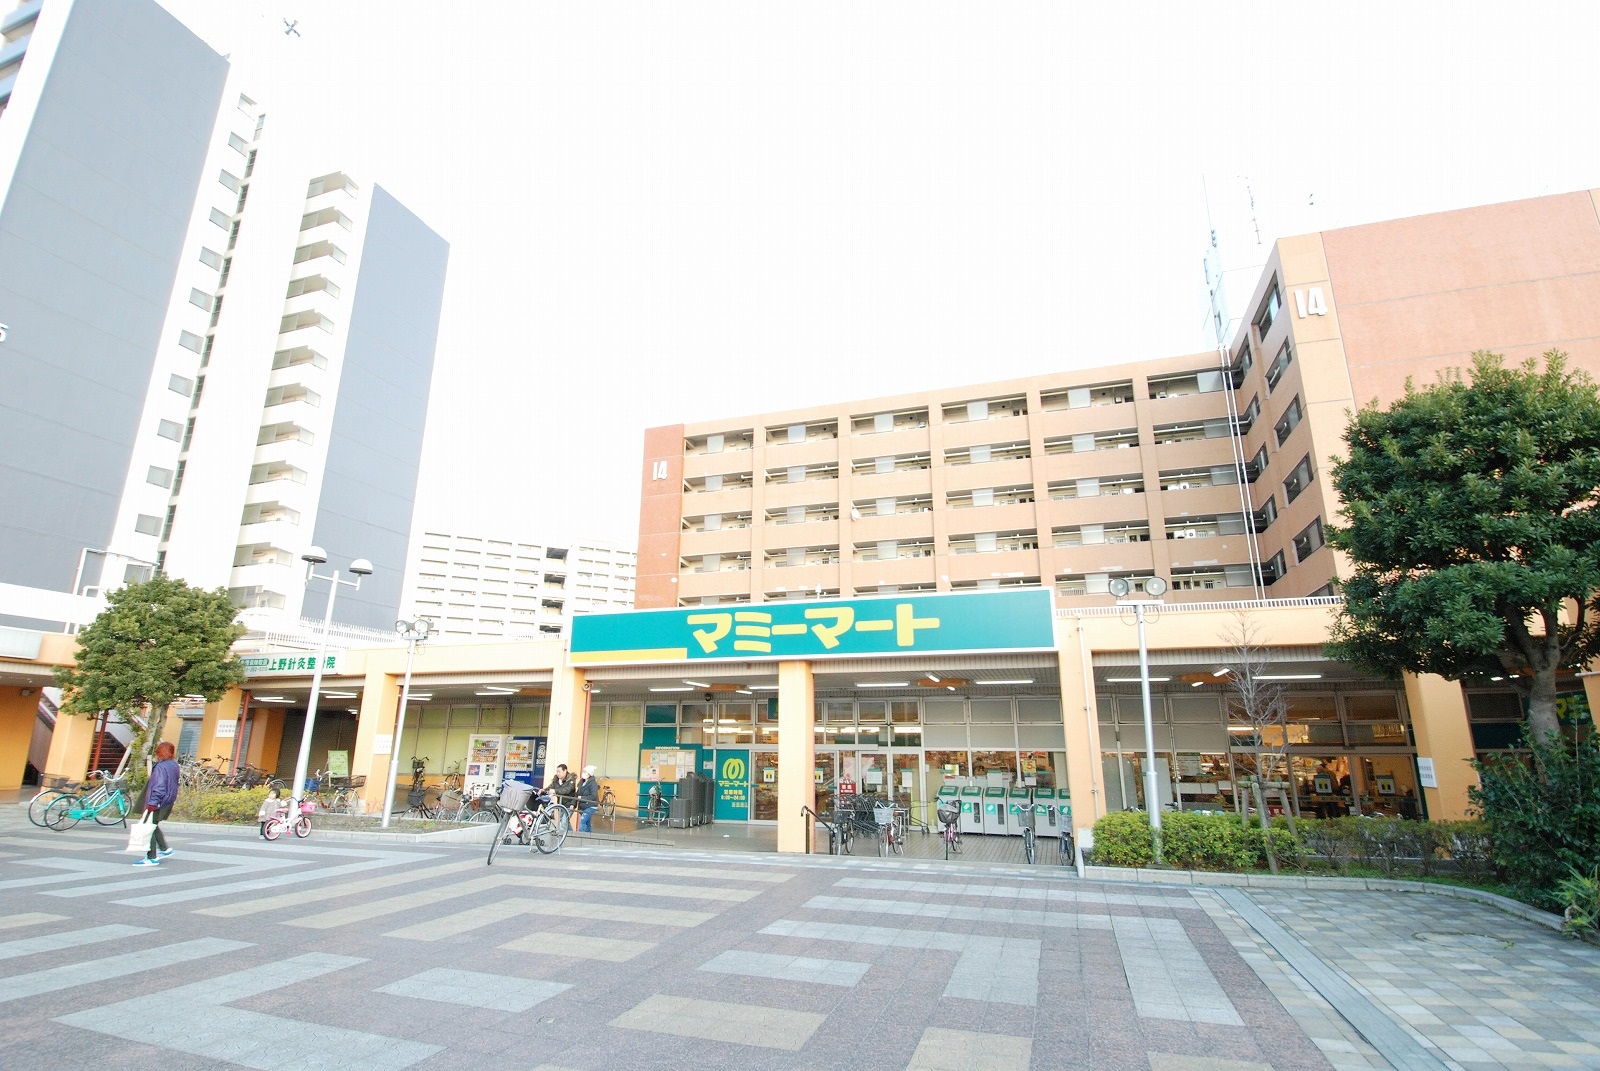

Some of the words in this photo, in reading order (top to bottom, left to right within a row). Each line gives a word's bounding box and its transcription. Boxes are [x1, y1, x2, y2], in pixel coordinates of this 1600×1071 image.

[1294, 287, 1328, 318] 14
[653, 460, 668, 480] 14
[687, 603, 940, 654] マミーマート
[268, 656, 336, 671] 上野針灸整院
[718, 780, 749, 788] マミーマート
